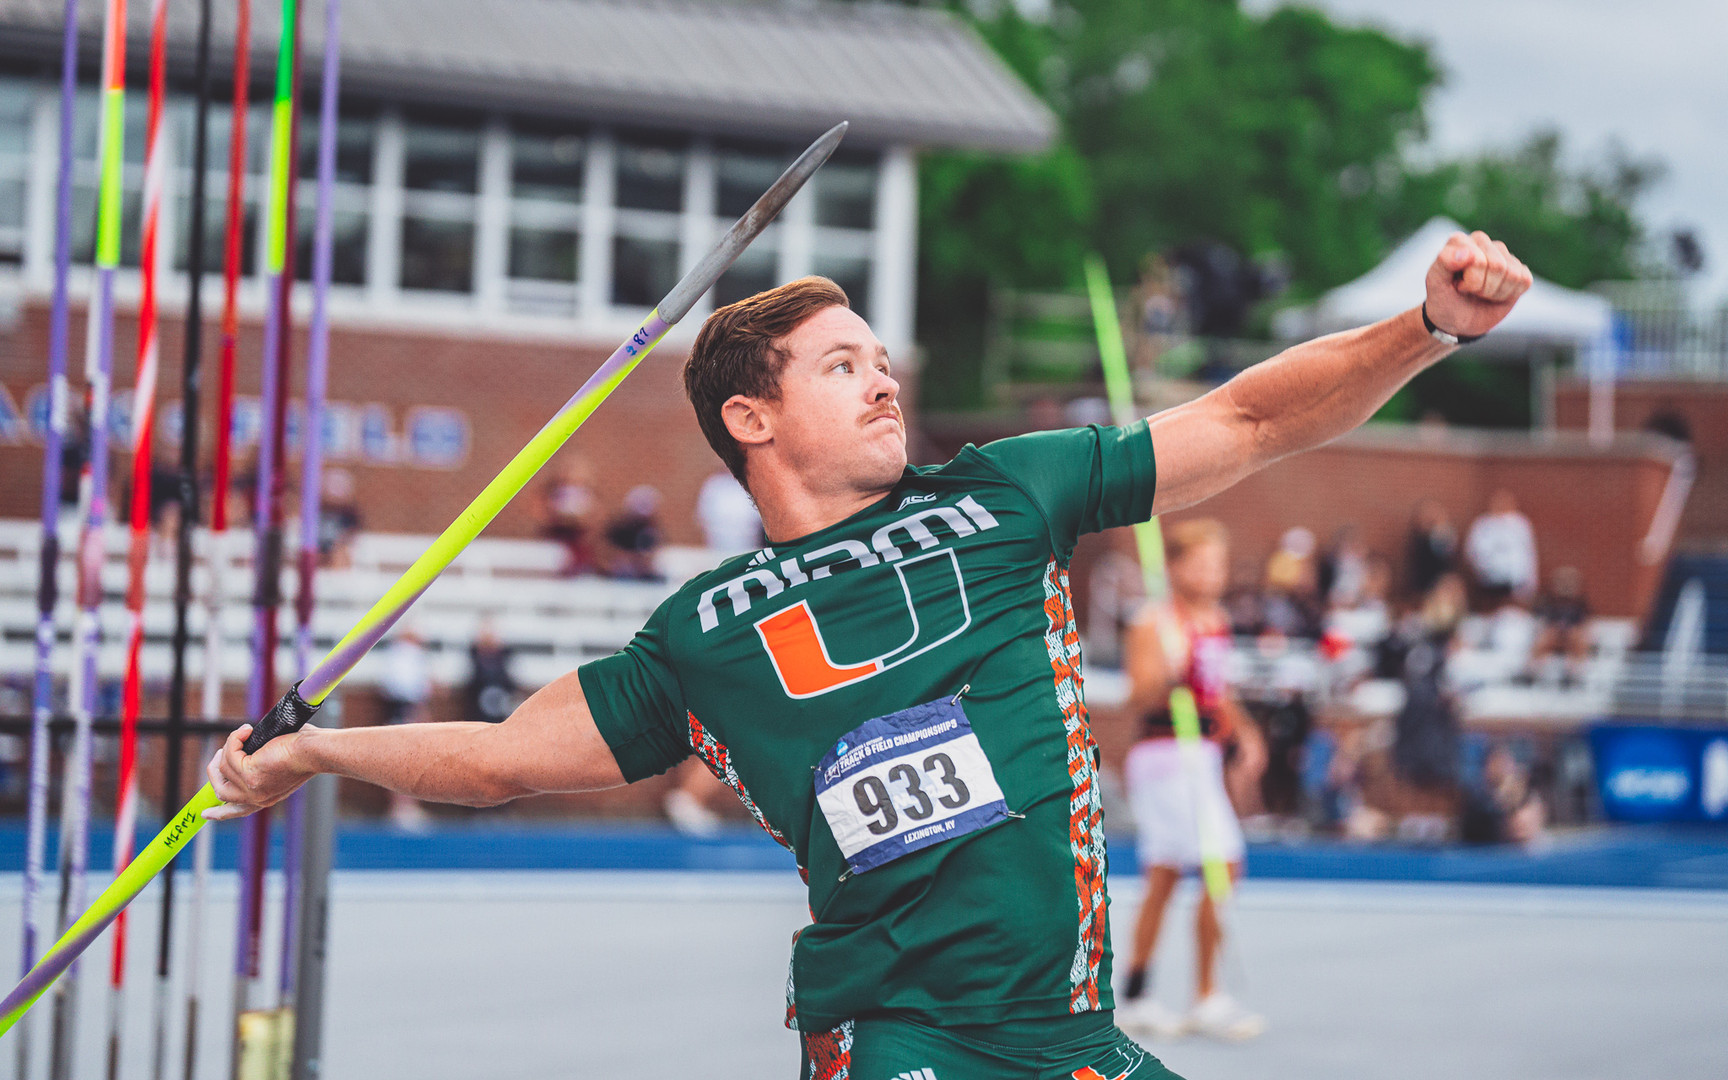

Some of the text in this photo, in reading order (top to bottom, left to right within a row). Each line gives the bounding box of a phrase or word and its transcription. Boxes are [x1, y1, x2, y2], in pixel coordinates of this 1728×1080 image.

[897, 492, 937, 511] ACC
[697, 495, 999, 633] MIAMI
[753, 547, 972, 700] U
[839, 749, 866, 769] TRACK
[871, 738, 894, 754] FIELD
[893, 718, 957, 747] CHAMPIONSHIPS
[852, 752, 970, 836] 933
[904, 819, 956, 845] LEXINGTON, KY
